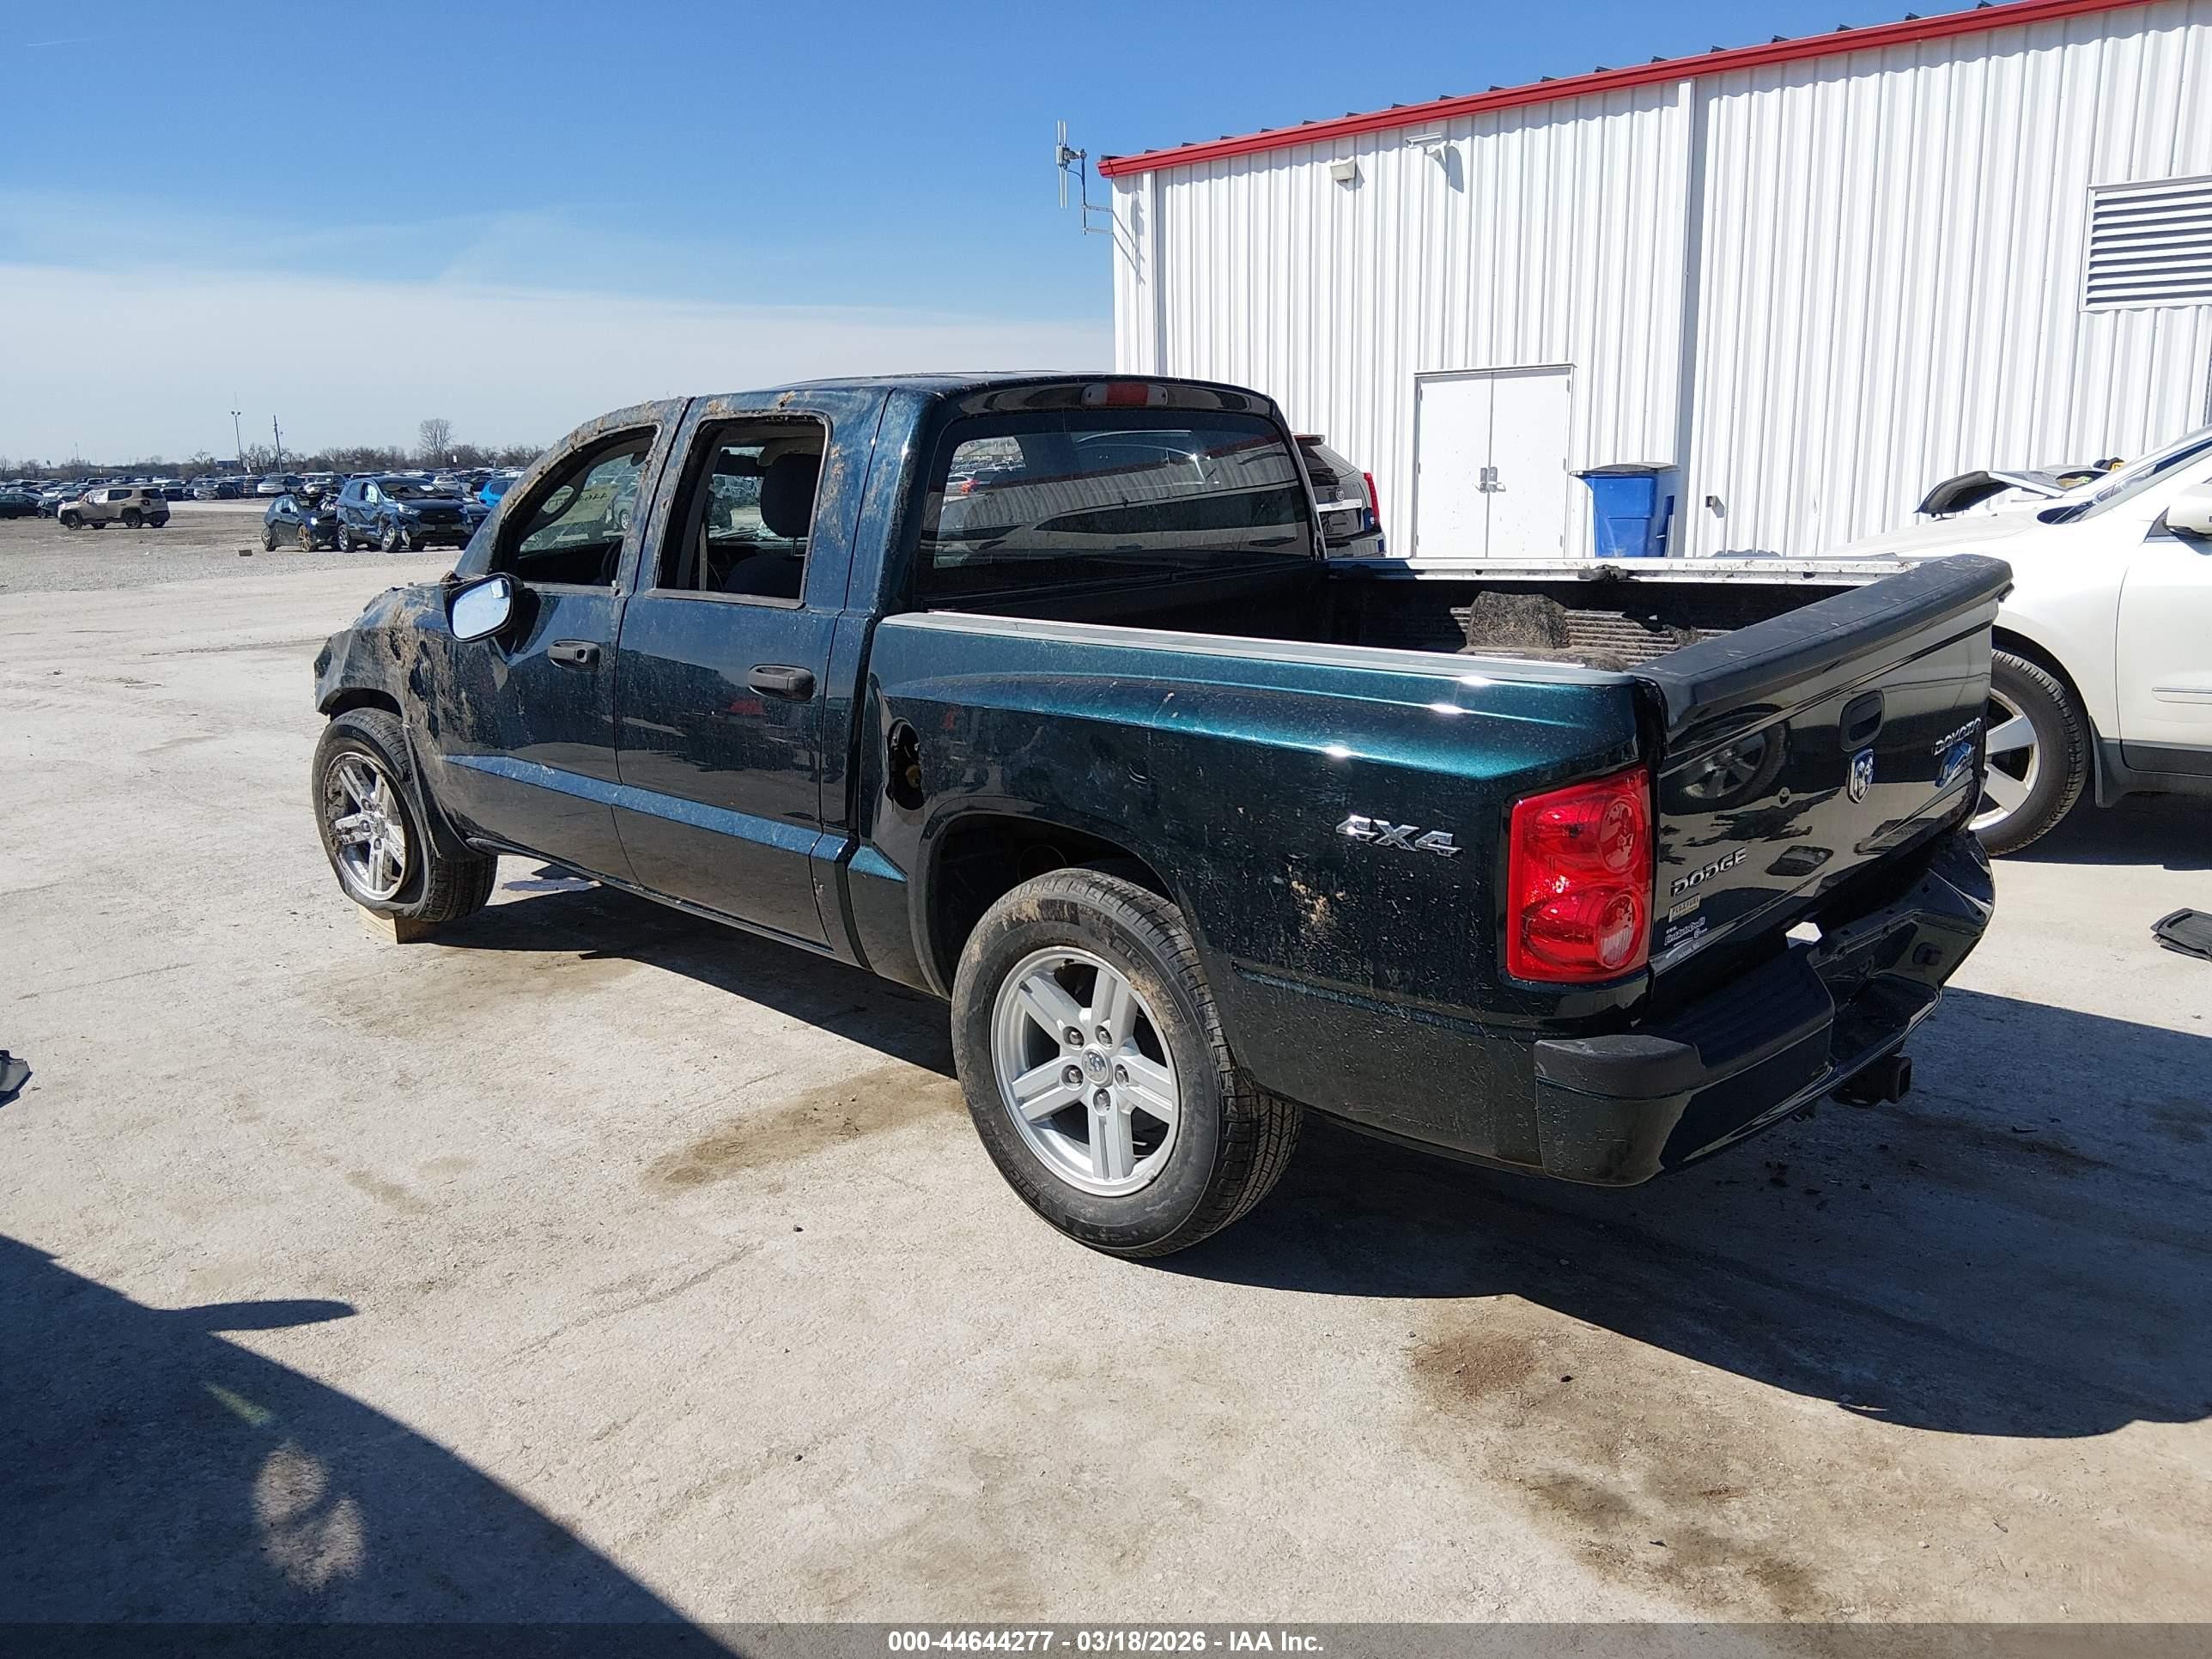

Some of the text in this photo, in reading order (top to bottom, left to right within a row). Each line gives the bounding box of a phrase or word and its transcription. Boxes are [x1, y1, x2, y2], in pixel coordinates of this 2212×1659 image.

[1933, 717, 1982, 757] DAKOTA
[1335, 814, 1464, 858] 4X4
[1670, 847, 1747, 897] DODGE
